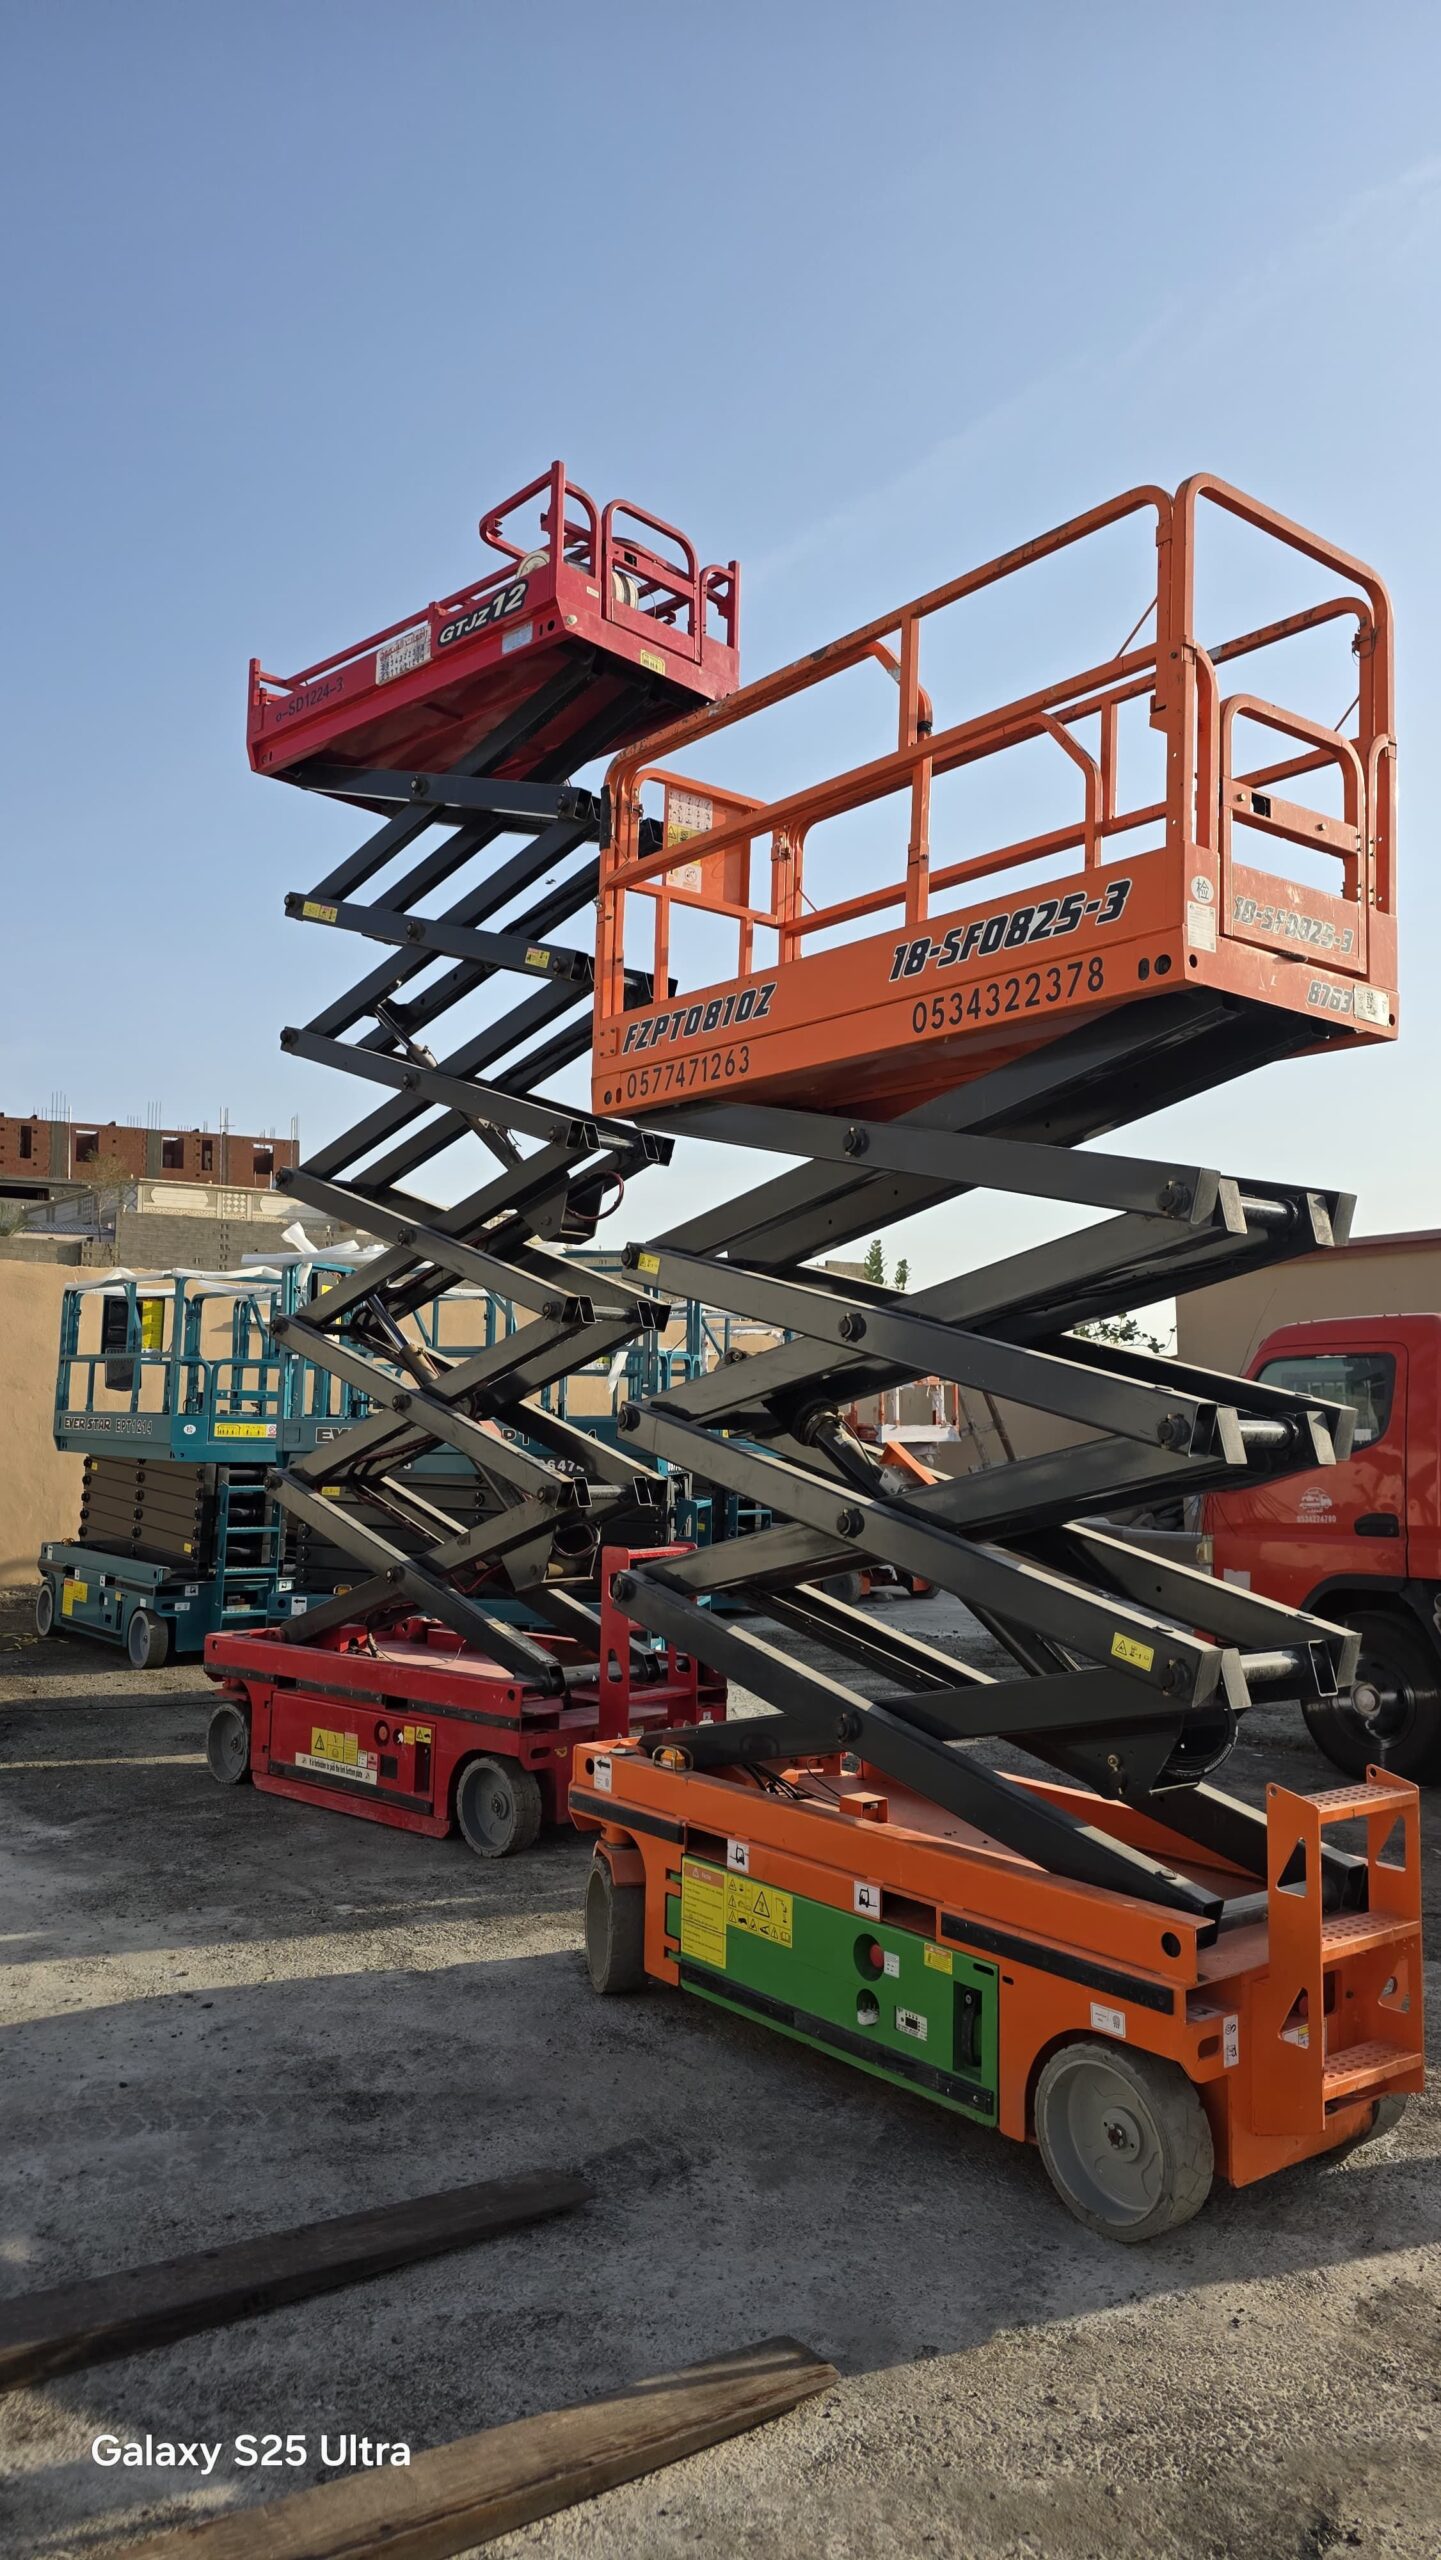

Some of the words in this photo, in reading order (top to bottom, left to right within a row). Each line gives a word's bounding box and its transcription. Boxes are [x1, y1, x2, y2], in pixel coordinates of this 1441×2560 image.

[889, 878, 1132, 982] 18-SF0825-3
[622, 982, 778, 1055] FZPT0810Z
[912, 956, 1104, 1033] 0534322378
[627, 1045, 750, 1099] 0577471263
[64, 1416, 86, 1430] EVER
[87, 1418, 111, 1431] STAR
